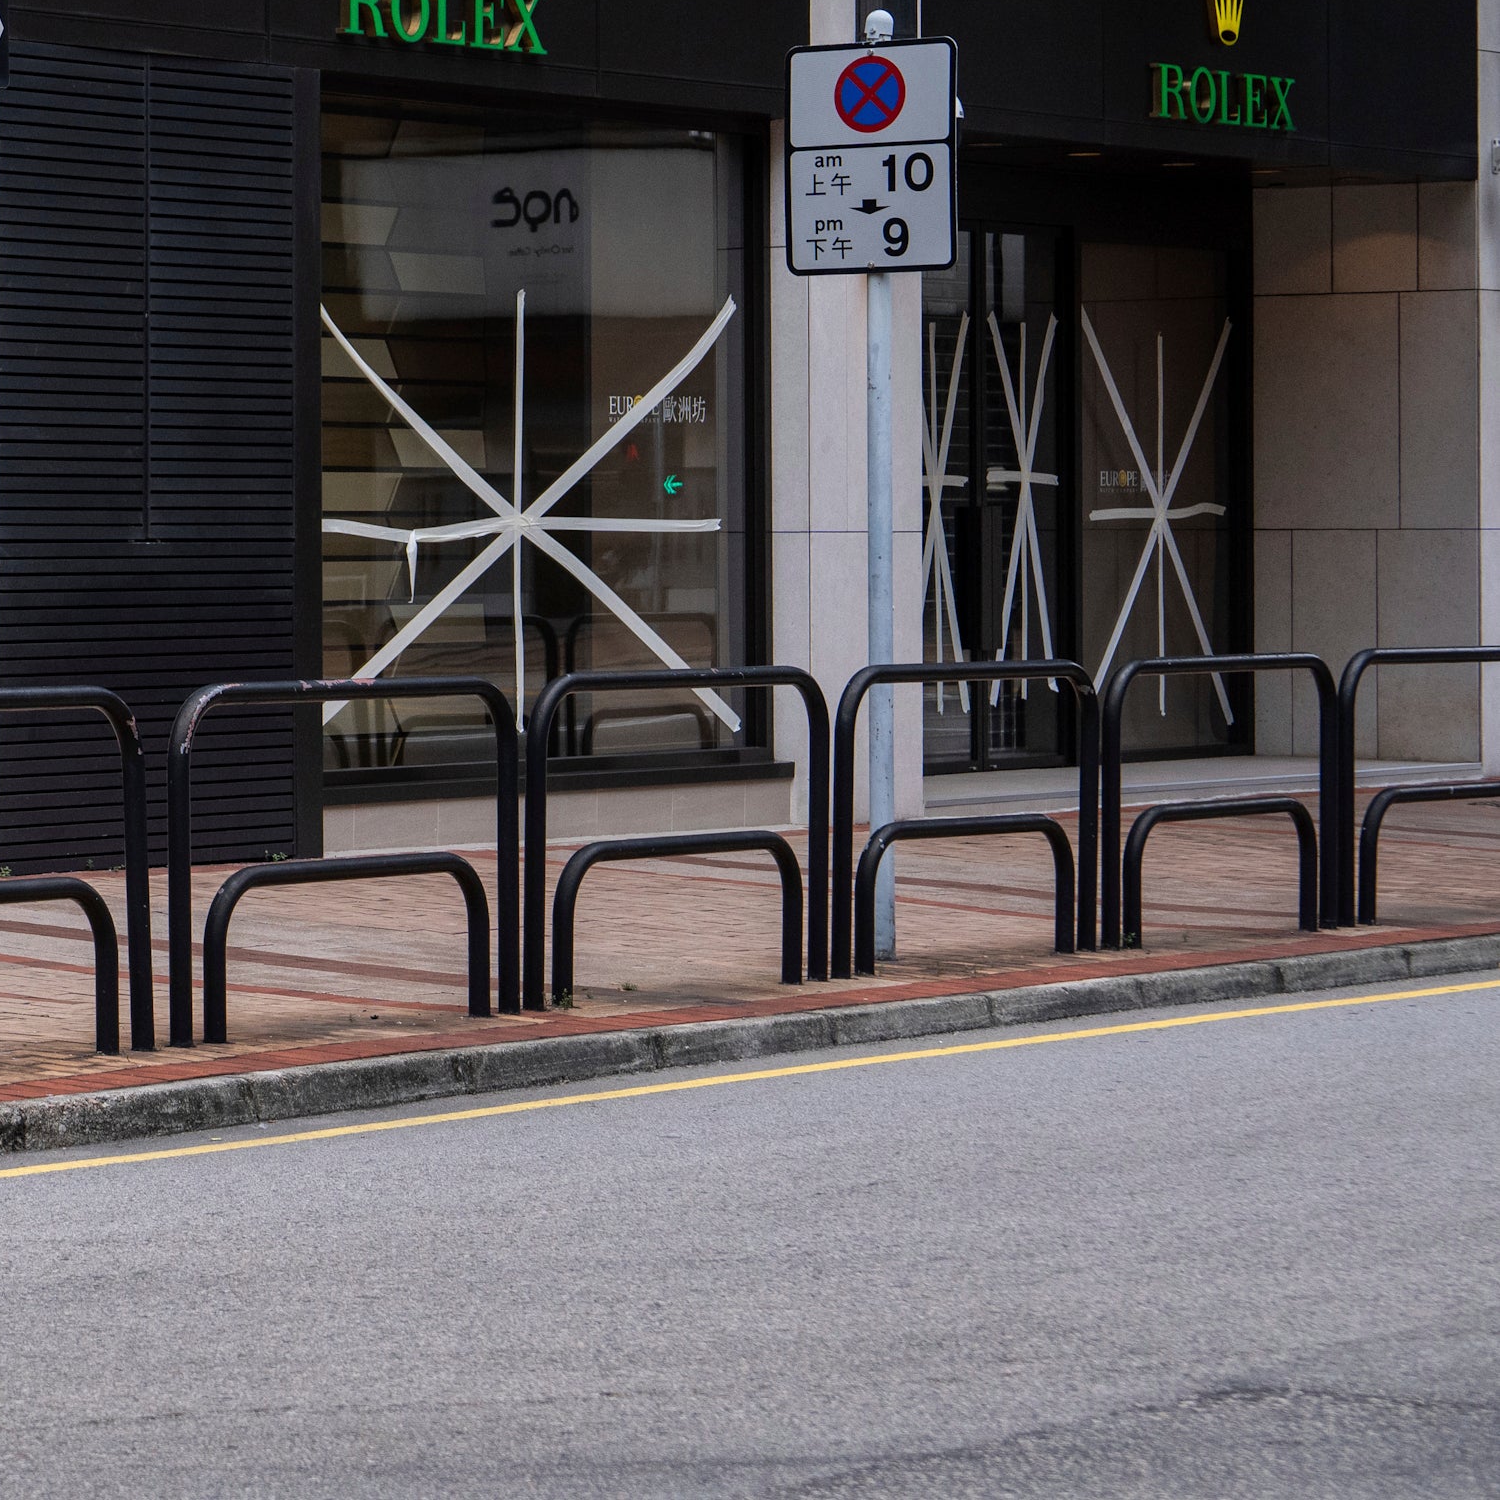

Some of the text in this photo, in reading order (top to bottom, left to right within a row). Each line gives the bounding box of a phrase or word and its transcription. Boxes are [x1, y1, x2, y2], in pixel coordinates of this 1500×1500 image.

[1150, 63, 1297, 131] ROLEX
[806, 173, 852, 196] 上午
[814, 152, 935, 192] am 10
[806, 237, 853, 261] 下午
[815, 217, 909, 257] pm 9
[662, 396, 706, 424] 歐洲坊
